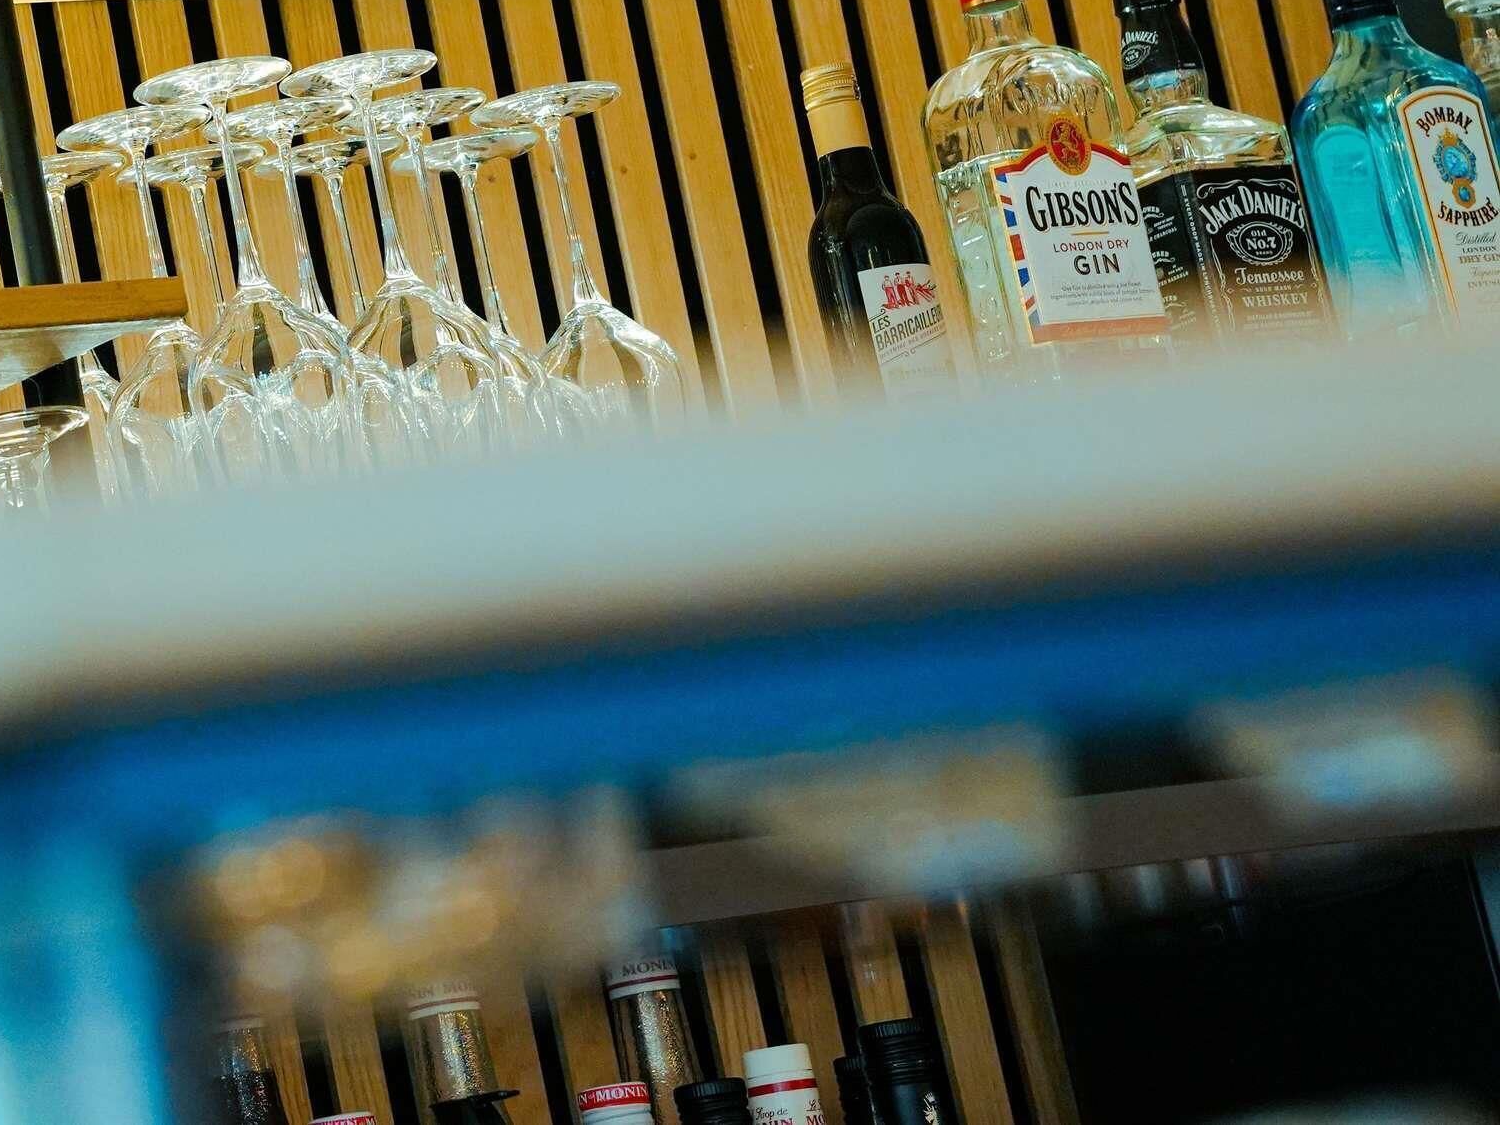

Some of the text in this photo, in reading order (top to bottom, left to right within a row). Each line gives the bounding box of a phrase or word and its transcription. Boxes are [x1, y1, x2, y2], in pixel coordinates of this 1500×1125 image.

[1416, 106, 1474, 138] BOMBAY
[1025, 182, 1139, 233] GIBSON'S
[1199, 185, 1308, 235] JACK DANIEL'S
[1438, 196, 1500, 228] SAPPHIRE
[1250, 229, 1268, 237] Old
[1053, 239, 1130, 253] LONDON DRY
[1245, 236, 1278, 251] No.7
[1462, 245, 1497, 254] LONDON
[1074, 254, 1121, 276] GIN
[1234, 267, 1306, 286] Tennessee
[1241, 291, 1309, 308] WHISKEY
[872, 315, 891, 335] LES
[595, 1085, 649, 1103] MONIN
